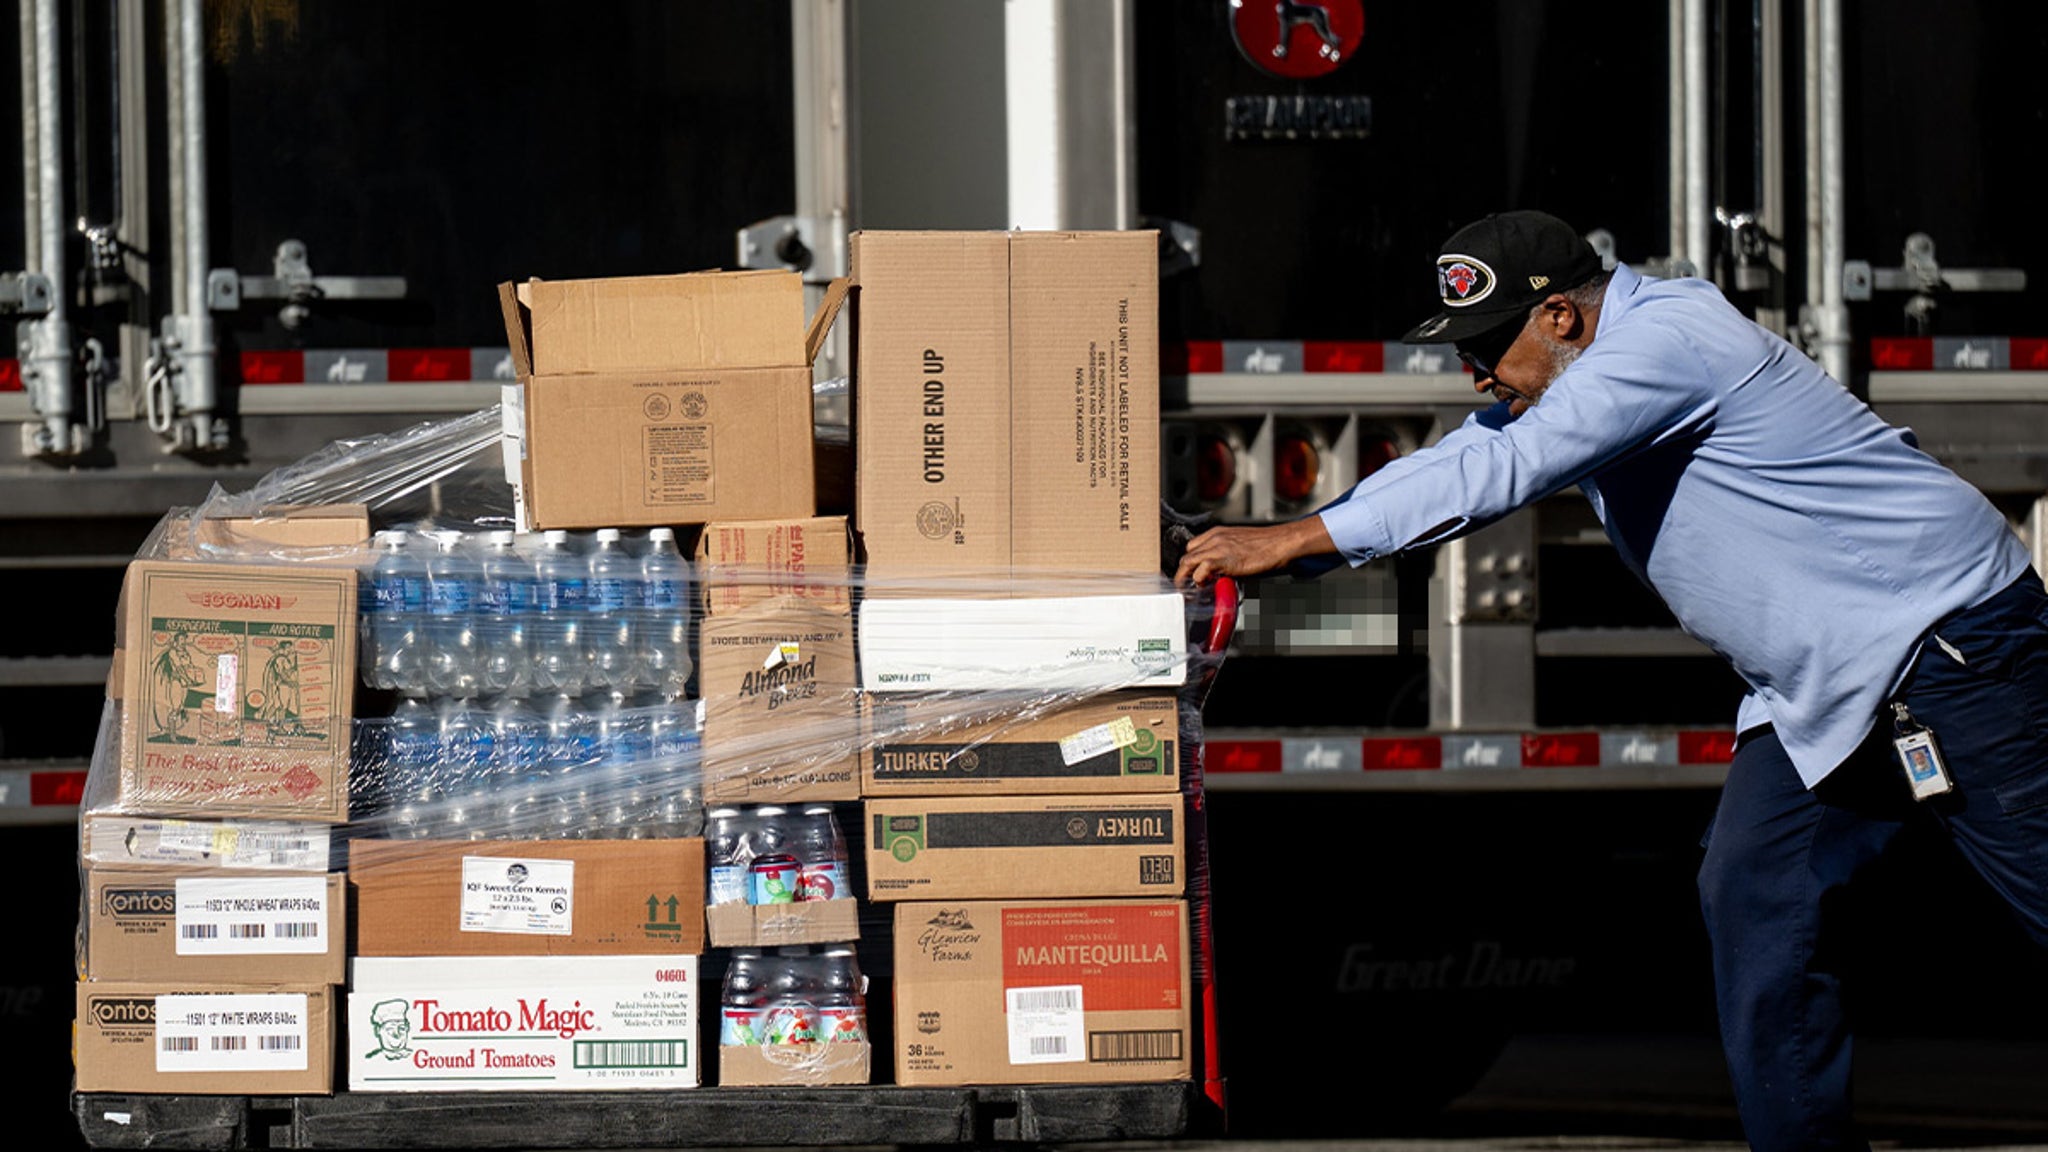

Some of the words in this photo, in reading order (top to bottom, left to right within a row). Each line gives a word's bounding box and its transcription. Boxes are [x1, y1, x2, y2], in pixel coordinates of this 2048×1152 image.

[1118, 298, 1128, 324] THIS
[1119, 326, 1128, 353] UNIT
[923, 349, 945, 375] UP
[1119, 356, 1128, 379] NOT
[923, 380, 945, 418] END
[1119, 382, 1129, 433] LABELED
[923, 423, 945, 484] OTHER
[1119, 436, 1129, 459] FOR
[1120, 462, 1129, 500] RETAIL
[1120, 503, 1129, 531] SALE
[201, 592, 281, 609] EGGMAN
[289, 625, 321, 637] ROTATE
[739, 654, 817, 698] Almond
[767, 681, 817, 710] Breeze
[145, 753, 177, 768] The
[182, 755, 219, 772] Best
[882, 751, 950, 773] TURKEY
[1096, 817, 1165, 838] TURKEY
[1142, 857, 1172, 873] DELI
[484, 883, 510, 892] Sweet
[512, 883, 534, 894] Corn
[535, 886, 568, 895] Kernels
[102, 890, 174, 912] Kontos
[233, 899, 256, 911] WHOLE
[256, 899, 278, 911] WHEAT
[279, 899, 301, 911] WRAPS
[917, 928, 982, 953] Glenview
[1016, 943, 1169, 967] MANTEQUILLA
[1336, 941, 1456, 993] Great
[1462, 940, 1576, 988] Dane
[656, 969, 687, 982] 04601
[88, 1001, 156, 1023] Kontos
[221, 1012, 245, 1025] WHITE
[245, 1012, 273, 1025] WRAPS
[413, 998, 512, 1033] Tomato
[517, 998, 595, 1038] Magic
[413, 1050, 475, 1069] Ground
[481, 1048, 556, 1068] Tomatoes
[908, 1044, 922, 1056] 36
